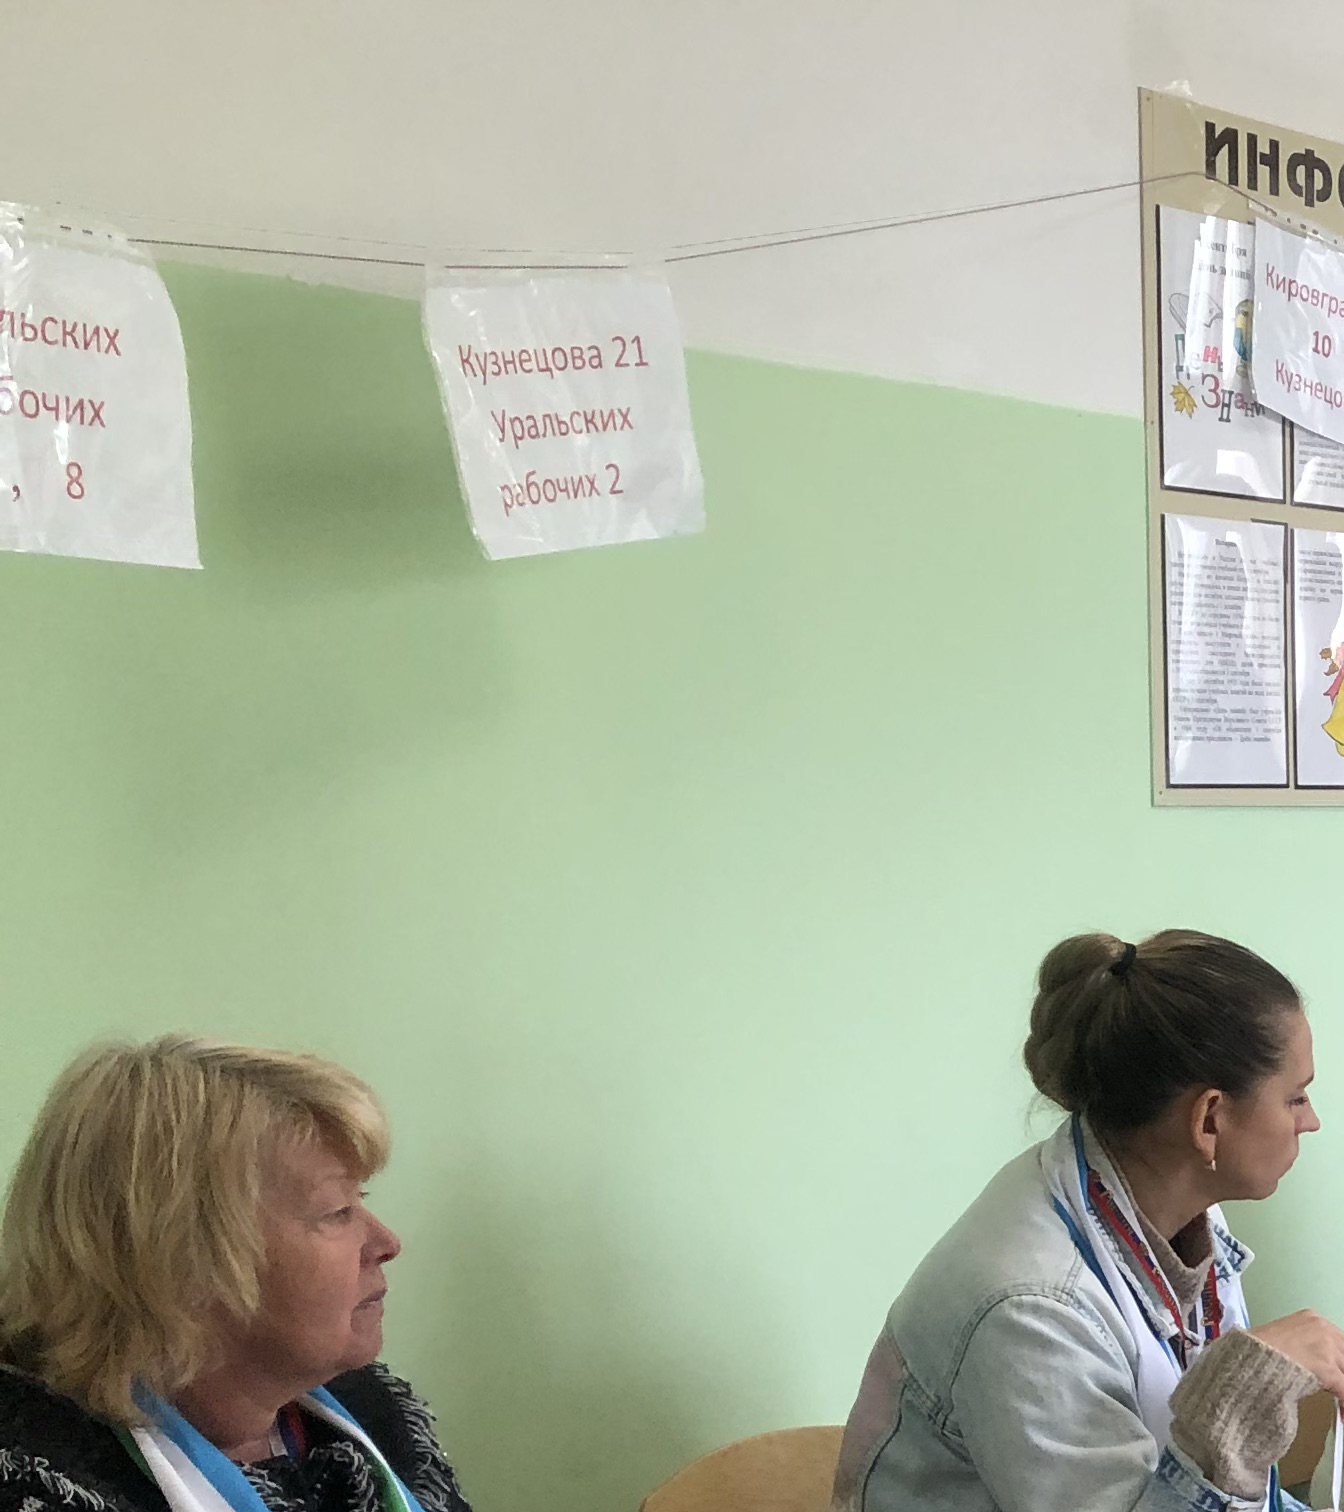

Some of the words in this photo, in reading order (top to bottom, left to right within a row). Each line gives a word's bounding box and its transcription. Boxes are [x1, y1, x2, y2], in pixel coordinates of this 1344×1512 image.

[458, 341, 604, 386] Кузнецова
[612, 335, 649, 370] 21
[1312, 331, 1332, 358] 10
[492, 405, 634, 450] Уральских
[66, 461, 85, 500] 8
[500, 470, 601, 516] рабочих
[604, 463, 625, 497] 2
